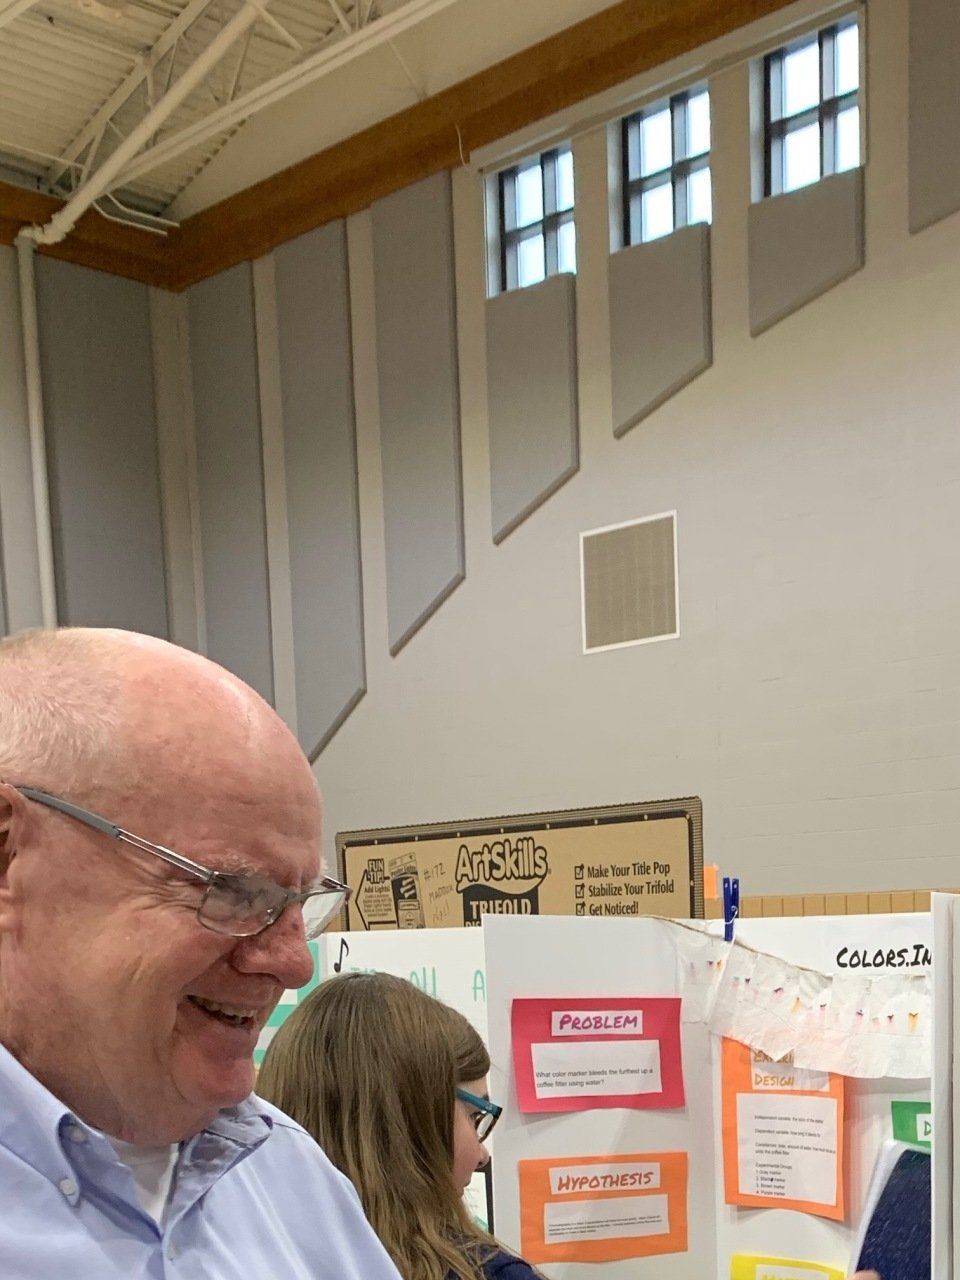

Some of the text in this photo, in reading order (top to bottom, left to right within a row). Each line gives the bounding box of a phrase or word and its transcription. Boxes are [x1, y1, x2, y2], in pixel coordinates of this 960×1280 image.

[368, 858, 384, 872] FUN
[456, 836, 548, 882] ArtSkills
[367, 872, 384, 884] TIP!
[588, 862, 670, 878] Make Your Title Pop
[588, 880, 674, 897] Stabilize Your Trifold
[589, 901, 639, 916] Get Noticed!
[559, 1014, 638, 1030] PROBLEM
[755, 1074, 794, 1087] DESIGN
[558, 1172, 654, 1191] HYPOTHESIS
